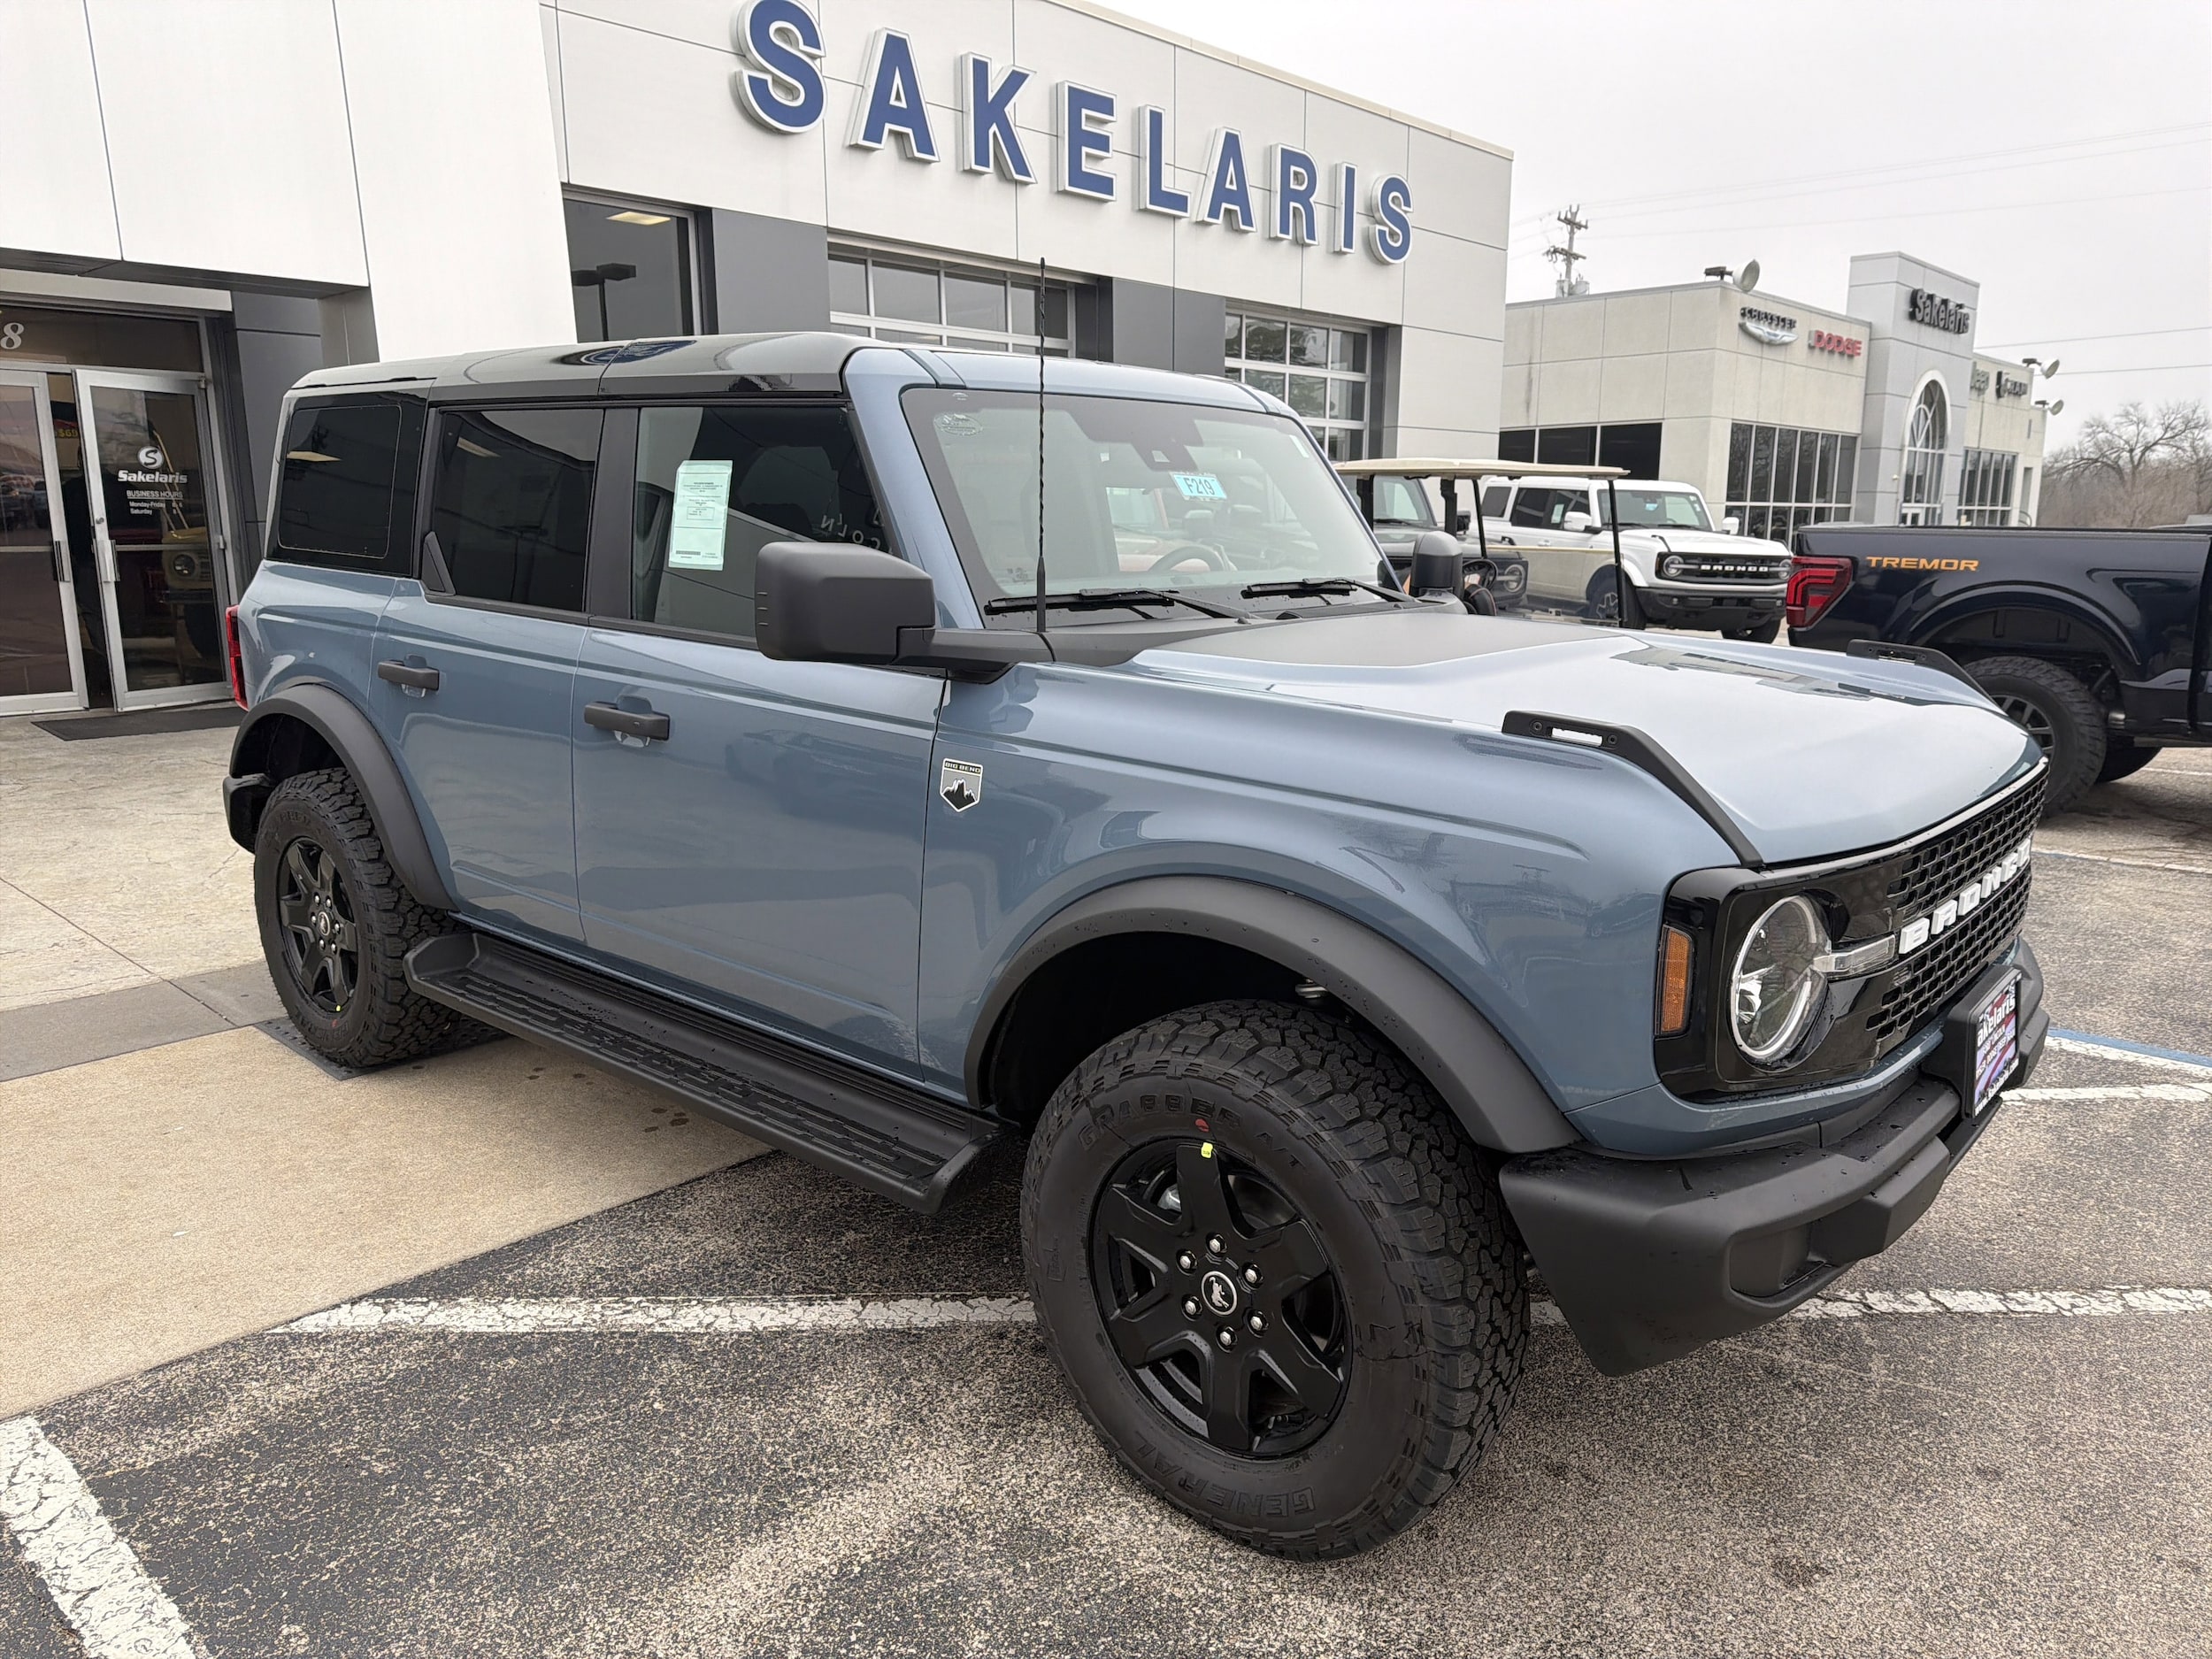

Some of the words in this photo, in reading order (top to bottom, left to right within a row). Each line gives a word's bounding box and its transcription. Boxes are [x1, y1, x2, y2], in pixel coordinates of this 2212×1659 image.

[736, 0, 1414, 265] SAKELARIS
[1811, 330, 1862, 357] DODGE
[118, 470, 188, 483] Sakelaris
[1183, 477, 1215, 495] F219
[1700, 564, 1769, 572] BRONCO
[1866, 556, 1979, 572] TREMOR
[958, 764, 980, 773] BEND
[1977, 997, 2016, 1048] akelaris
[1078, 1094, 1243, 1152] GRABBER
[1135, 1431, 1317, 1517] GENERAL
